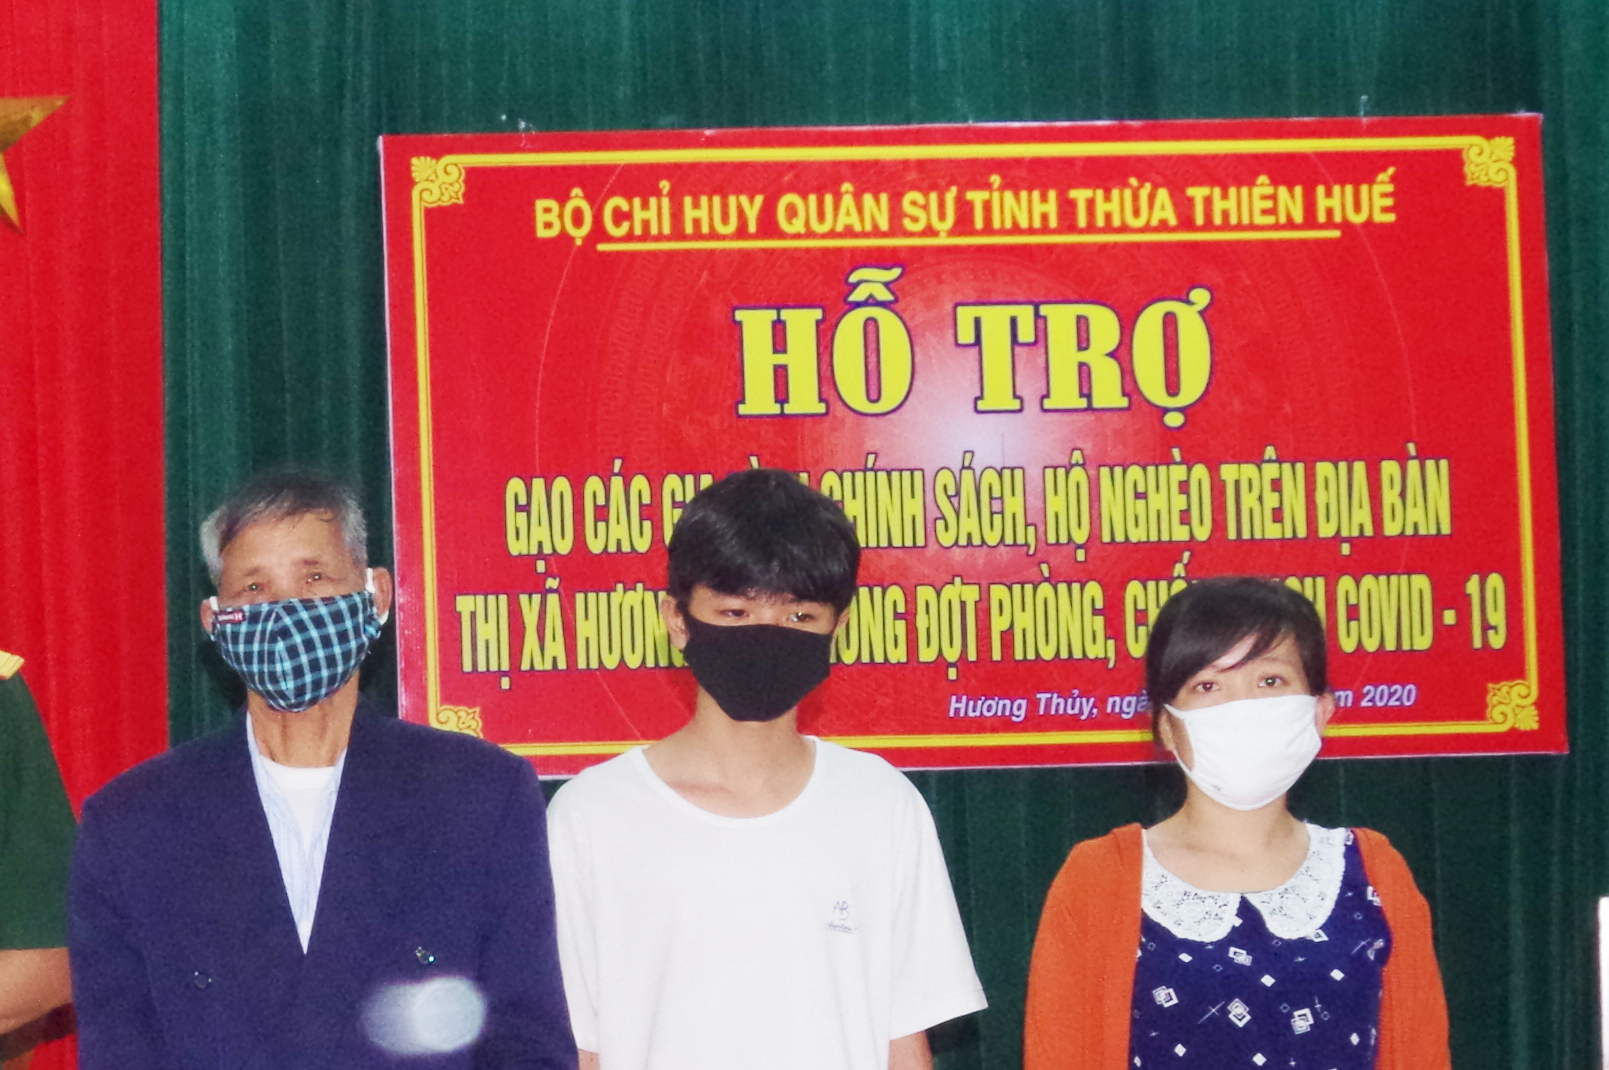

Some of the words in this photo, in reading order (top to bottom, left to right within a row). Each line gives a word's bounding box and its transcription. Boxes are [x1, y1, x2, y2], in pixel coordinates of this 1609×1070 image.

[535, 187, 592, 247] BỘ
[603, 179, 671, 237] CHỈ
[683, 194, 764, 235] HUY
[776, 182, 890, 235] QUÂN
[902, 186, 957, 238] SỰ
[965, 174, 1058, 230] TỈNH
[1068, 177, 1178, 229] THỪA
[1185, 174, 1304, 226] THIÊN
[1316, 166, 1397, 224] HUẾ
[733, 264, 915, 417] HỖ
[954, 286, 1214, 429] TRỢ
[505, 475, 575, 574] GẠO
[587, 458, 653, 555] CÁC
[934, 450, 1039, 556] SÁCH,
[1043, 450, 1091, 564] HỘ
[1099, 447, 1214, 544] NGHÈO
[1219, 445, 1308, 542] TRÊN
[1314, 460, 1374, 557] ĐỊA
[1380, 442, 1452, 537] BÀN
[455, 594, 511, 689] THỊ
[519, 577, 568, 670] XÃ
[915, 577, 981, 680] ĐỢT
[989, 563, 1117, 668] PHÒNG,
[1335, 573, 1434, 654] COVID
[1464, 571, 1508, 650] 19
[949, 695, 1027, 722] Hương
[1036, 689, 1098, 720] Thủy,
[1360, 684, 1416, 708] 2020
